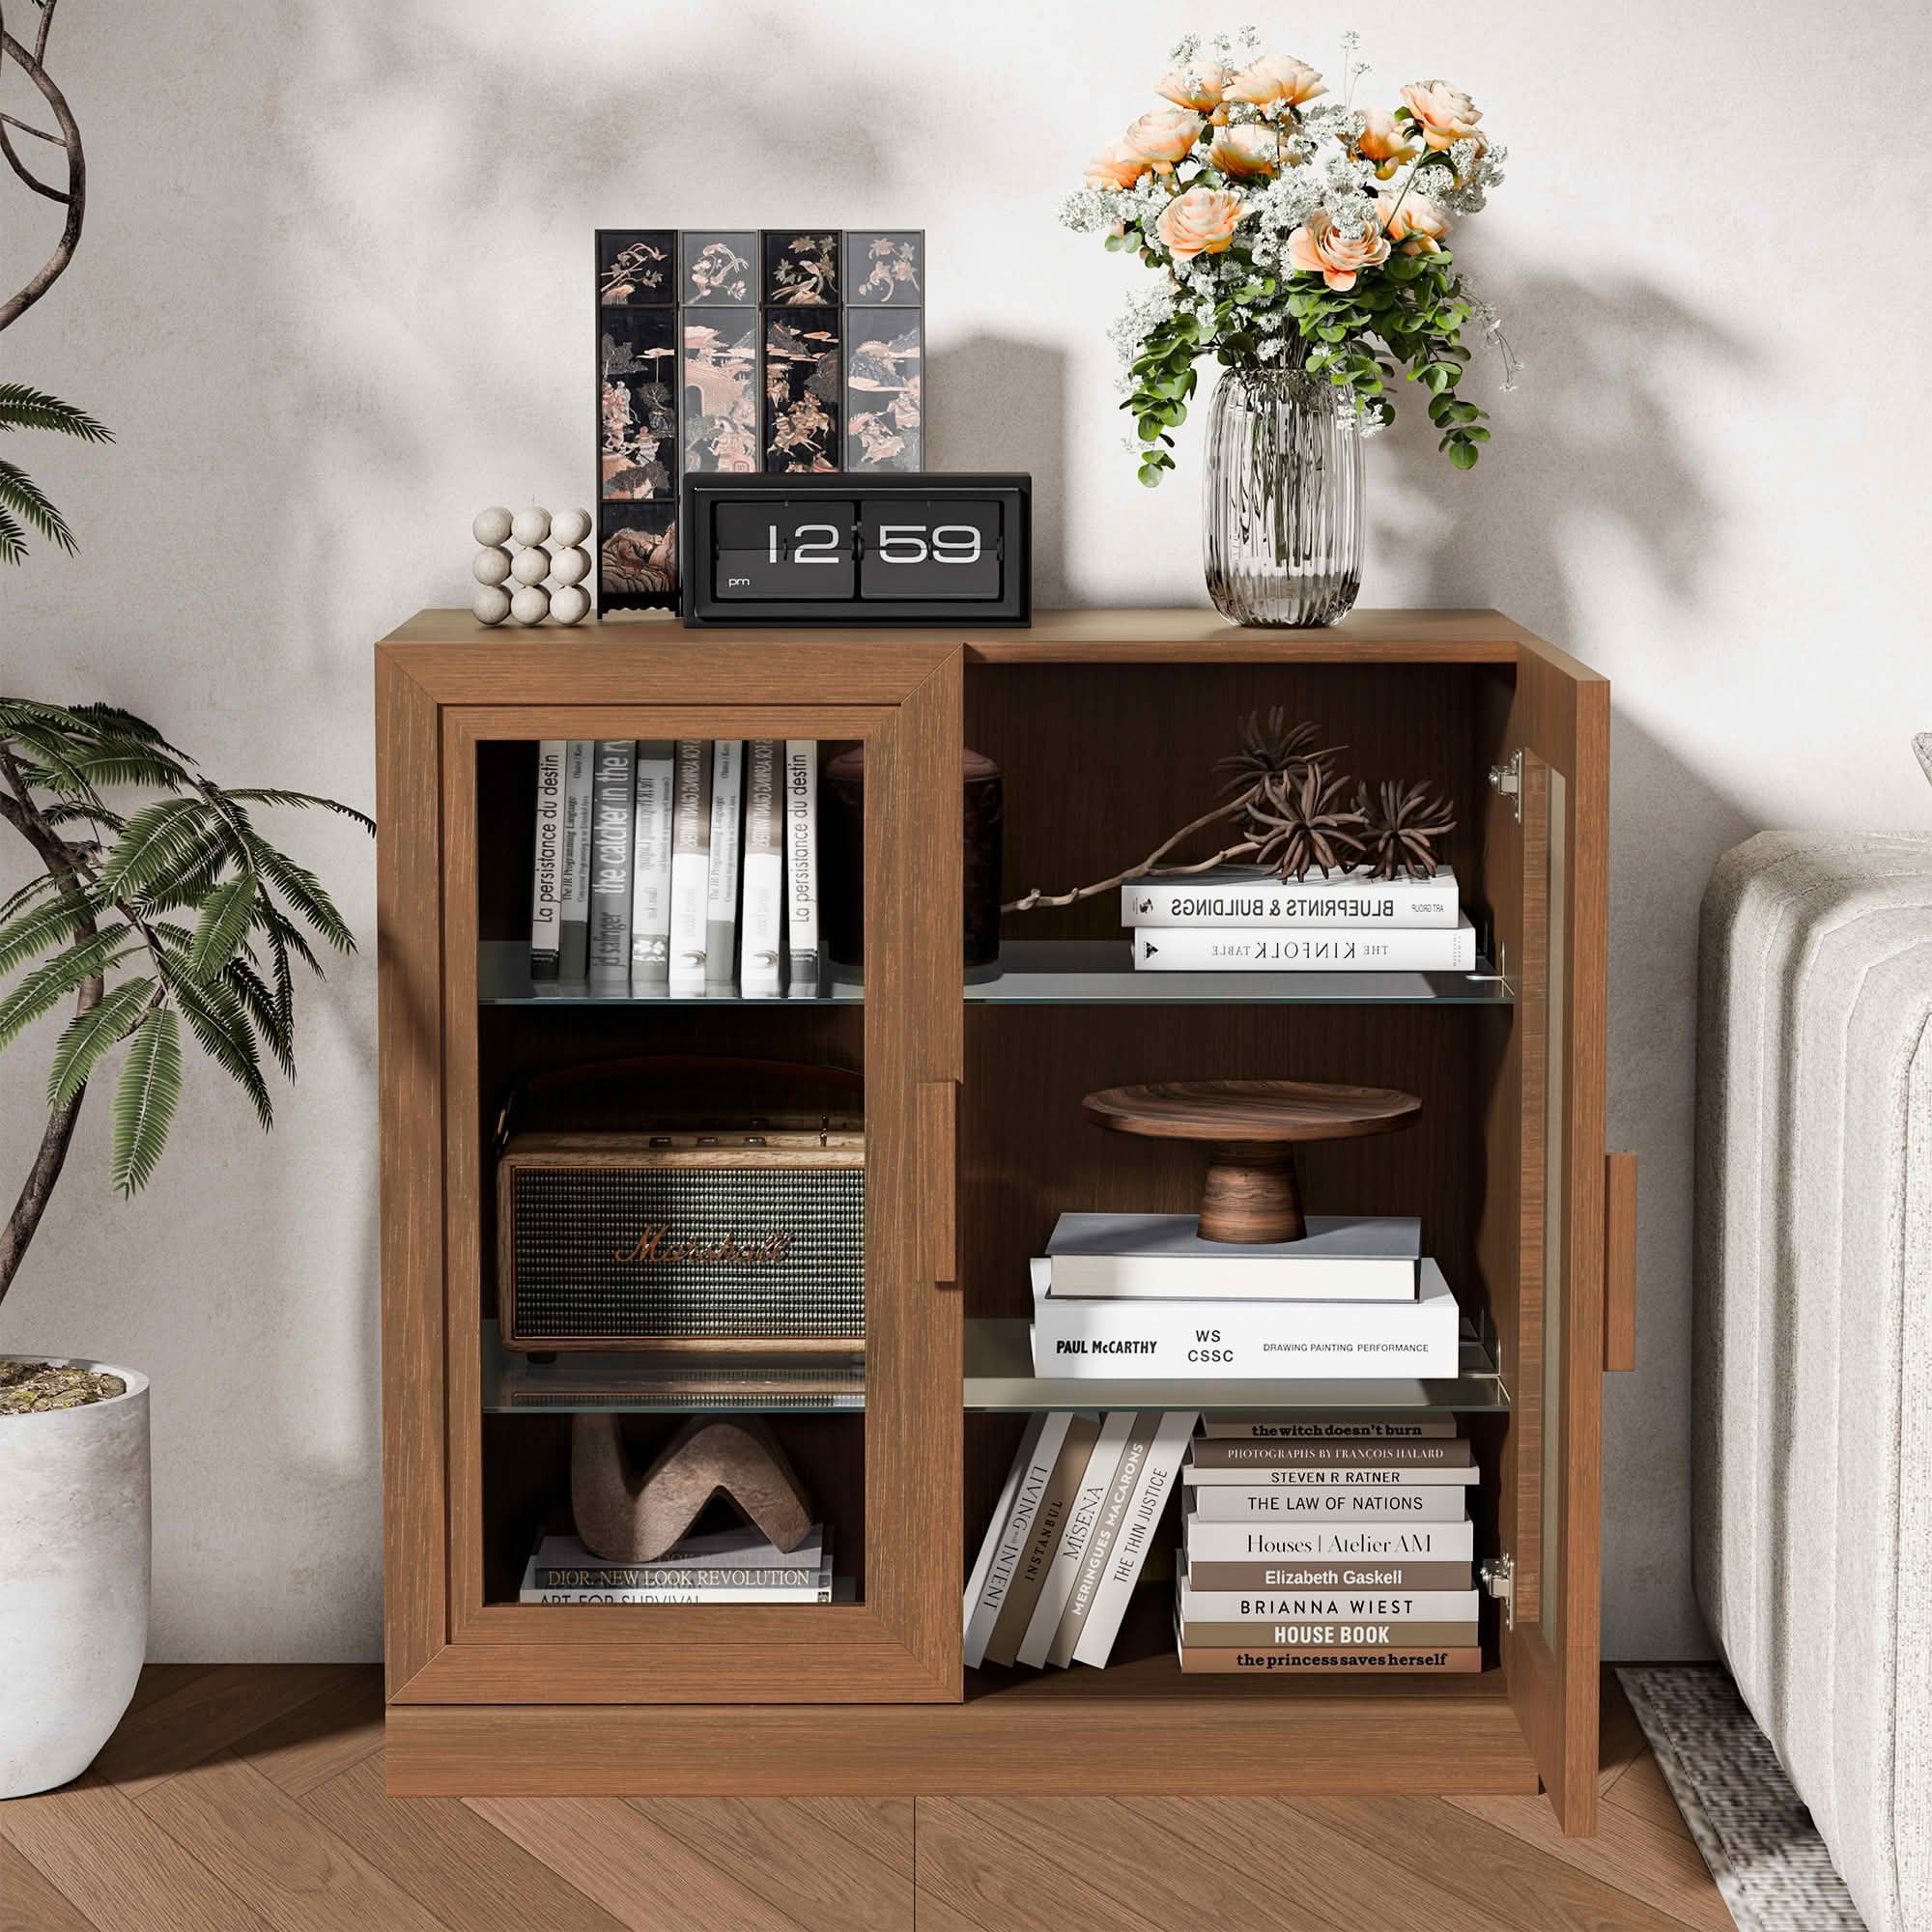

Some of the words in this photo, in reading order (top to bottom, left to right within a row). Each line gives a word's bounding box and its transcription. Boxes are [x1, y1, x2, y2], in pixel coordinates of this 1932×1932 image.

[769, 525, 839, 564] 12
[879, 525, 981, 564] 59
[728, 577, 751, 587] pm
[537, 754, 559, 796] destin
[594, 756, 629, 783] the
[787, 753, 808, 796] destin
[594, 787, 628, 802] in
[535, 801, 557, 819] du
[787, 801, 809, 819] du
[593, 804, 628, 865] catcher
[534, 823, 562, 905] persistance
[789, 823, 817, 905] persistance
[591, 868, 628, 895] the
[532, 908, 554, 923] La
[789, 907, 810, 923] La
[1195, 1329, 1221, 1343] WS
[1056, 1340, 1089, 1354] PAUL
[1092, 1340, 1158, 1354] McCARTHY
[1263, 1343, 1308, 1352] DRAWING
[1310, 1343, 1353, 1352] PAINTING
[1356, 1343, 1430, 1352] PERFORMANCE
[1187, 1350, 1235, 1363] CSSC
[1252, 1425, 1278, 1436] the
[1279, 1425, 1324, 1436] witch
[1385, 1425, 1423, 1436] burn
[1227, 1448, 1317, 1460] PHOTOGRAPHS
[1319, 1448, 1332, 1460] BY
[1396, 1448, 1444, 1460] HALARD
[1270, 1471, 1325, 1484] STEVEN
[1330, 1471, 1340, 1484] R
[1345, 1471, 1401, 1484] RATNER
[1012, 1465, 1048, 1531] LIVING
[1137, 1467, 1168, 1523] JUSTICE
[1247, 1496, 1280, 1510] THE
[1286, 1496, 1321, 1510] LAW
[1324, 1496, 1347, 1510] OF
[1352, 1496, 1424, 1510] NATIONS
[1071, 1529, 1112, 1616] MERINGUES
[1105, 1442, 1144, 1527] MACARONS
[1024, 1500, 1063, 1582] INSTANBUL
[1123, 1523, 1148, 1554] THIN
[1247, 1534, 1313, 1553] Houses
[1327, 1534, 1392, 1553] Atelier
[1394, 1534, 1431, 1553] AM
[600, 1570, 639, 1586] NEW
[643, 1570, 693, 1586] LOOK
[697, 1570, 810, 1586] REVOLUTION
[982, 1544, 1019, 1609] INTENT
[1113, 1556, 1135, 1583] THE
[1264, 1570, 1339, 1585] Elizabeth
[1343, 1570, 1403, 1585] Gaskell
[1239, 1600, 1339, 1615] BRIANNA
[1350, 1600, 1413, 1615] WIEST
[1274, 1626, 1335, 1644] HOUSE
[1340, 1626, 1390, 1644] BOOK
[1236, 1654, 1264, 1666] the
[1266, 1654, 1339, 1669] princess
[1340, 1655, 1386, 1666] saves
[1387, 1653, 1448, 1666] herself
